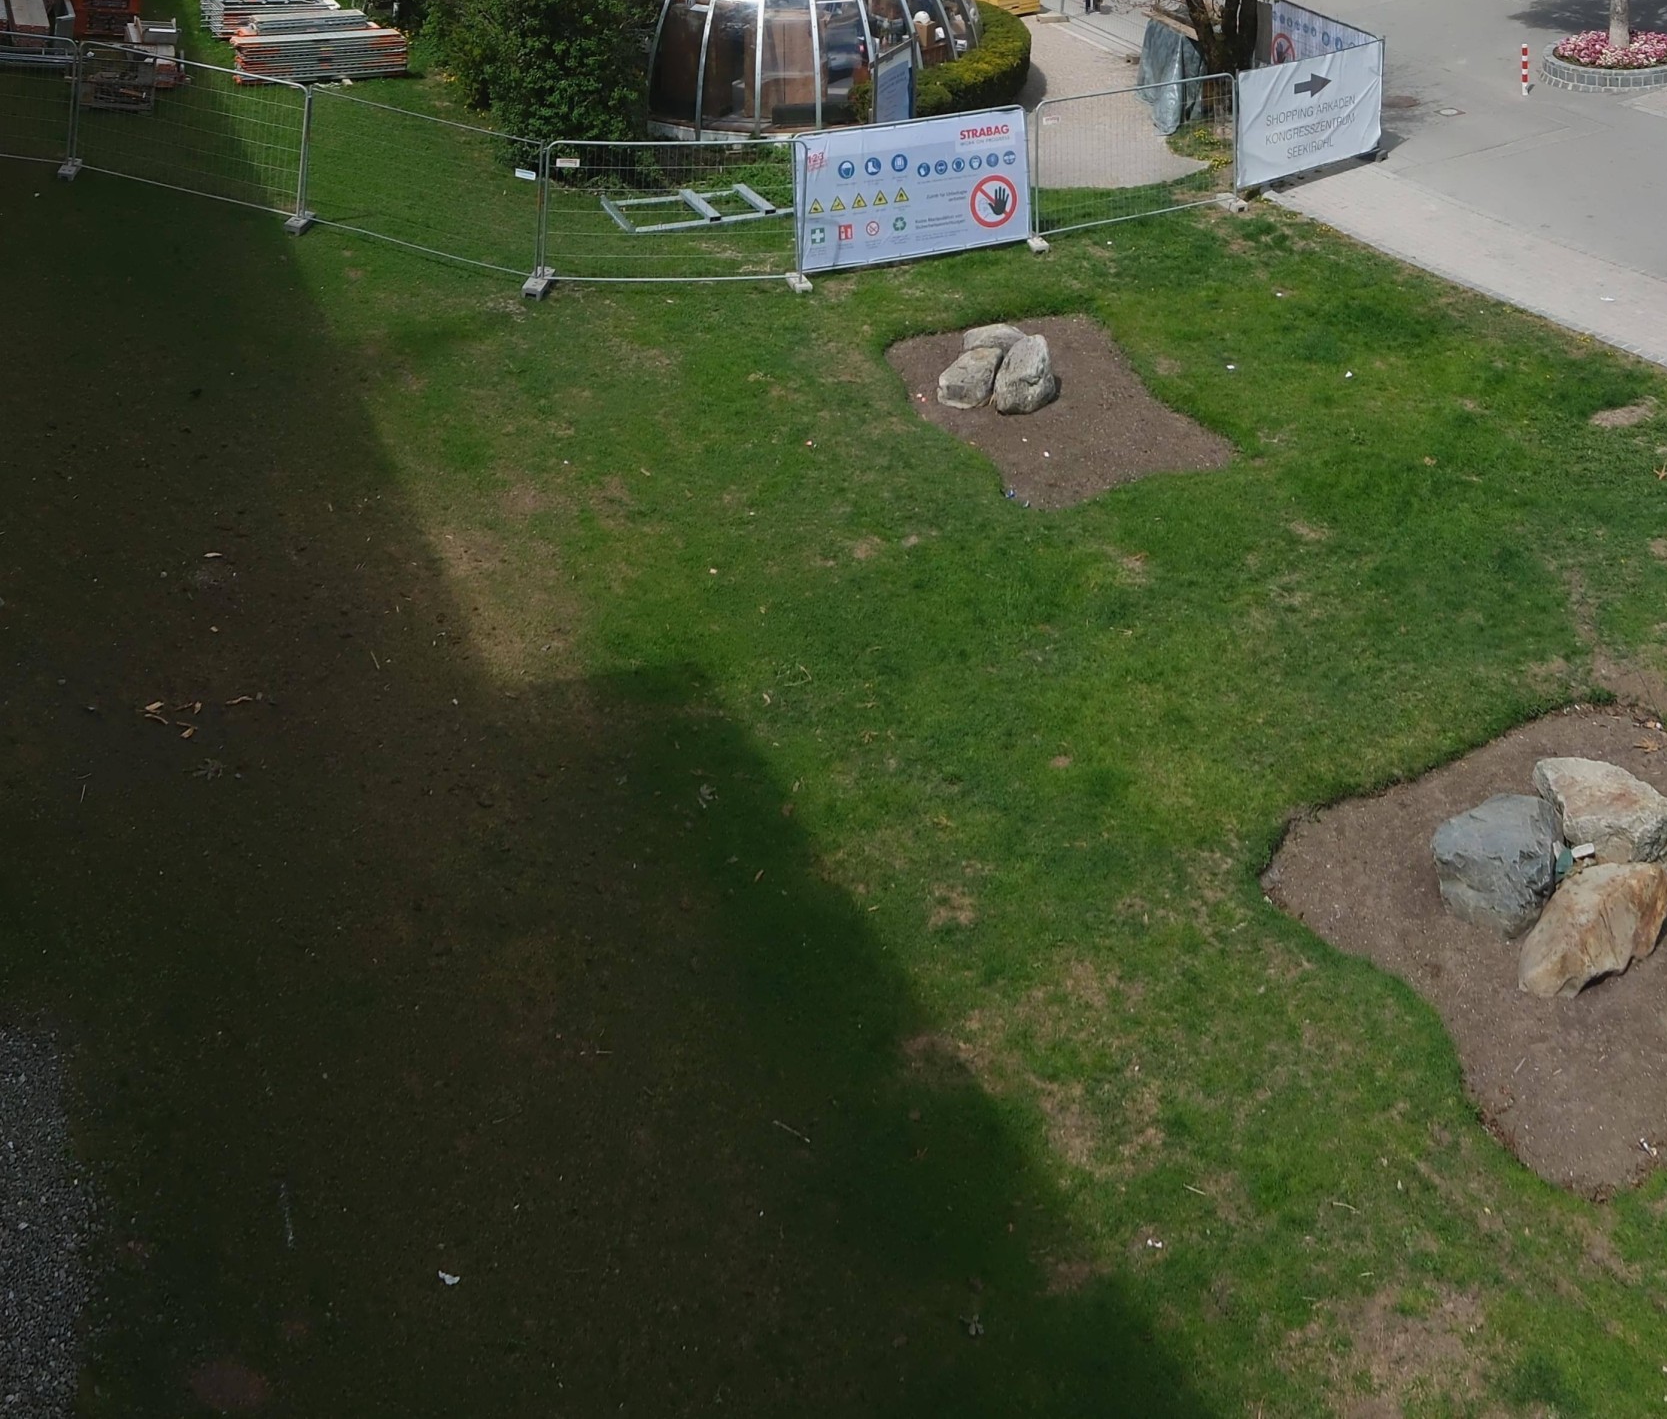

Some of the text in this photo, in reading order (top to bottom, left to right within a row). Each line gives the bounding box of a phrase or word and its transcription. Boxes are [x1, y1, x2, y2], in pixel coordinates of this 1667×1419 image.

[1265, 95, 1356, 127] SHOPPING ARKADEN
[960, 124, 1010, 140] STRABAG
[1265, 112, 1356, 145] KONGRESSZENTRUM
